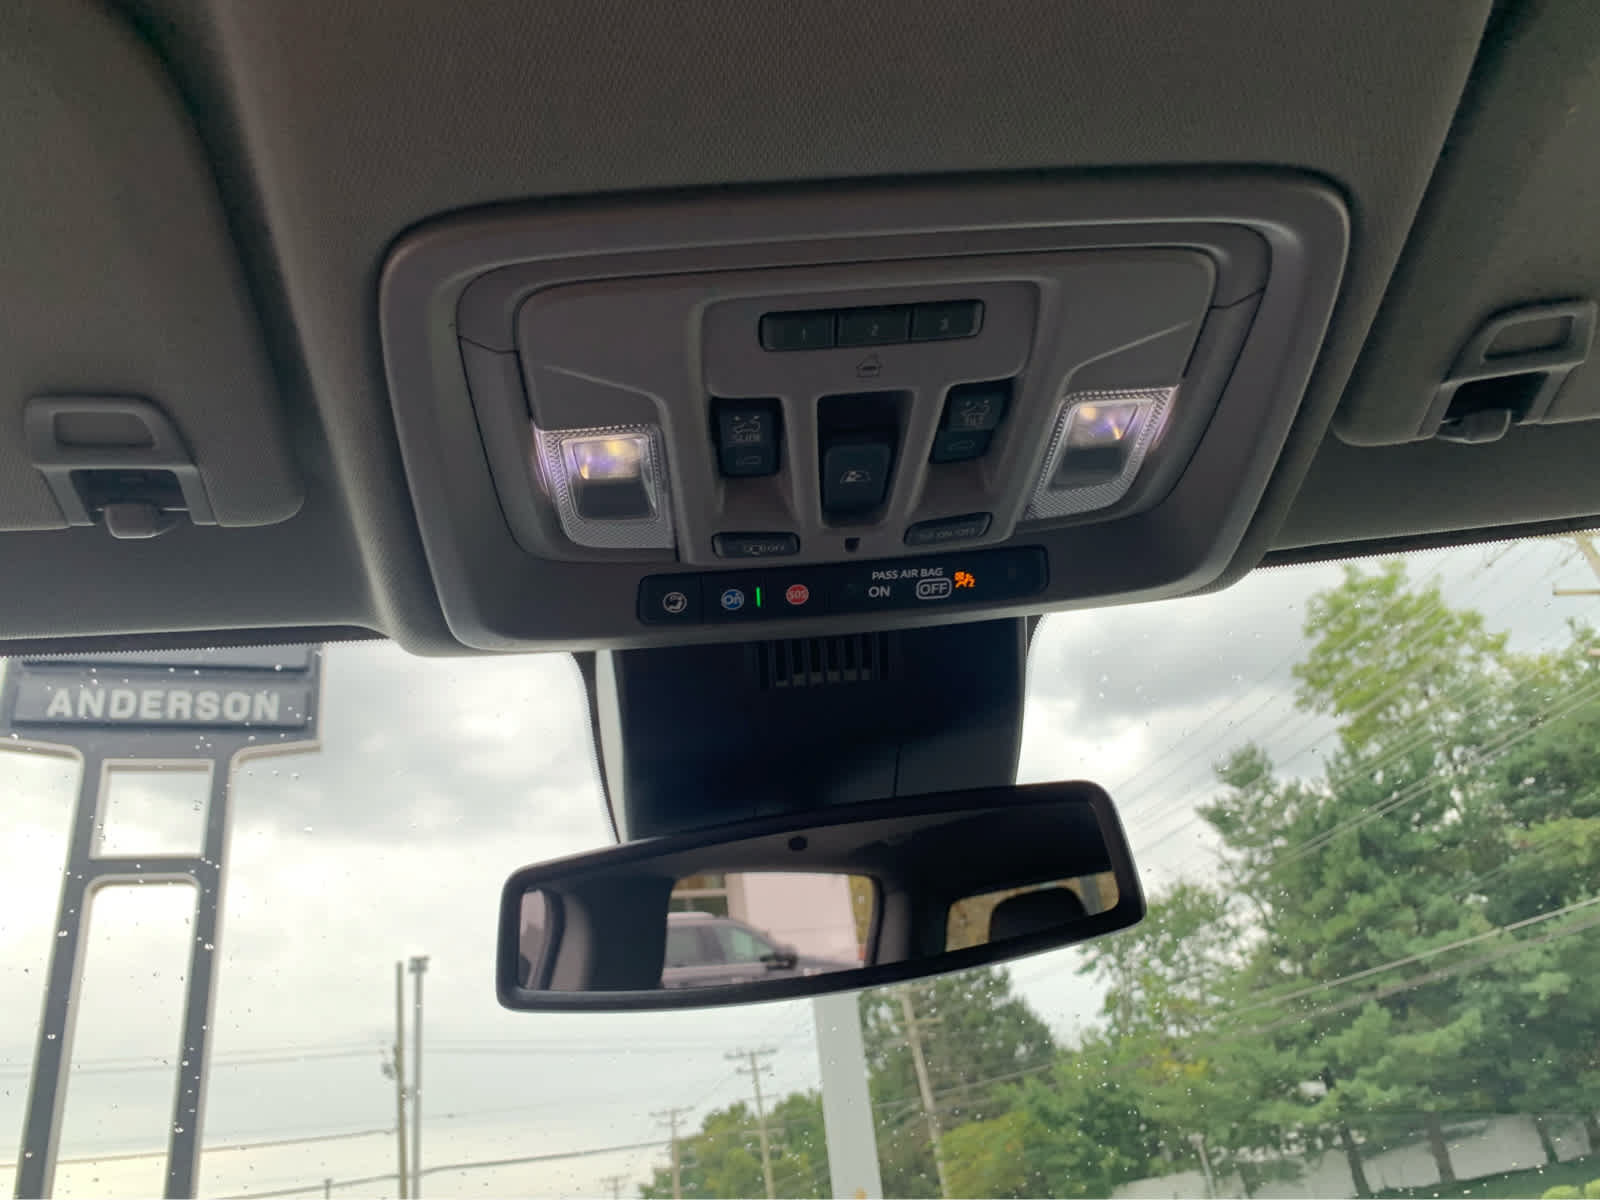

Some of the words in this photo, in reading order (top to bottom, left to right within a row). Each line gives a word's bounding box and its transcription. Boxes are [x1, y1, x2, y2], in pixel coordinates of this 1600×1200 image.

[872, 569, 898, 580] PASS
[900, 568, 919, 579] AIR
[920, 567, 943, 578] BAG
[868, 585, 890, 598] ON
[919, 582, 948, 596] OFF
[786, 590, 808, 602] SOS
[46, 687, 281, 721] ANDERSON
